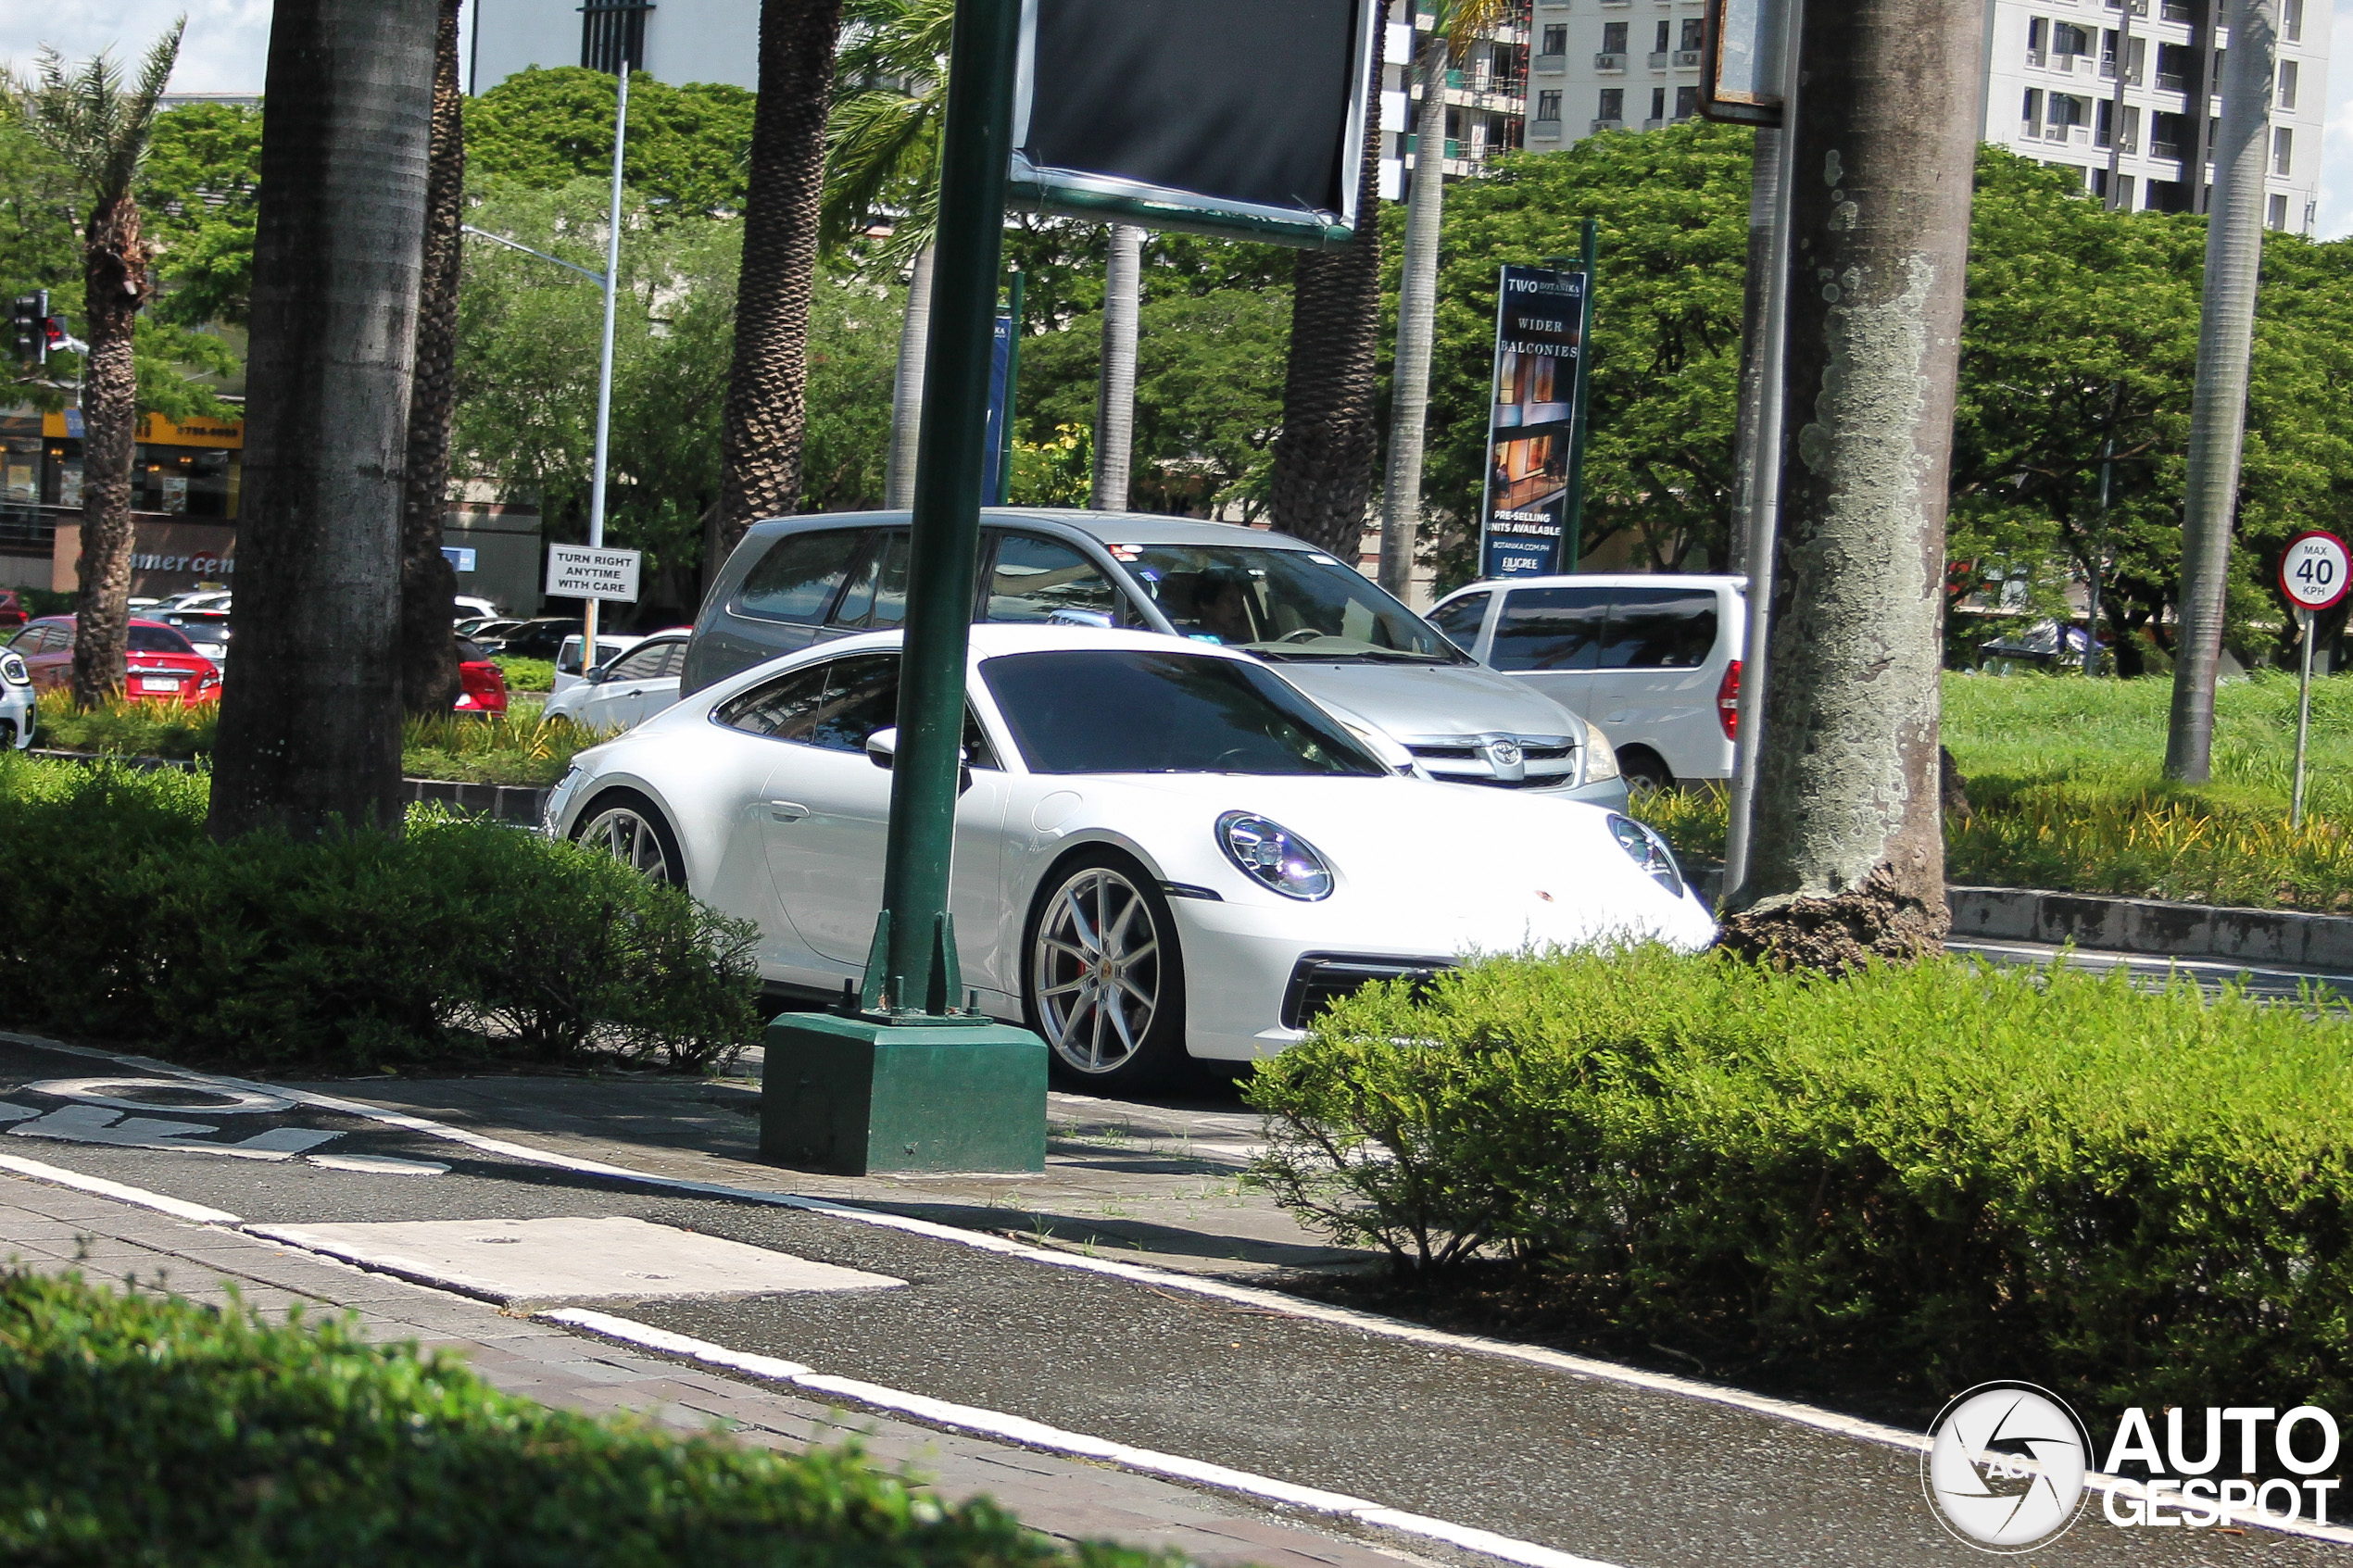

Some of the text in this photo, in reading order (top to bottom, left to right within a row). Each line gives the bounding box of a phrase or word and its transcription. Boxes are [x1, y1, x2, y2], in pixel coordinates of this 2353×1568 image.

[1507, 279, 1538, 294] TWO
[1518, 318, 1563, 332] WIDER
[1501, 340, 1578, 358] BALCONIES
[1494, 510, 1551, 523] PRE-SELLING
[1486, 521, 1562, 536] UNITS AVAILABLE
[2303, 545, 2327, 556] MAX
[557, 553, 633, 568] TURN RIGHT
[565, 567, 622, 579] ANYTIME
[2296, 558, 2334, 584] 40
[558, 579, 626, 593] WITH CARE
[2302, 585, 2326, 596] KPH
